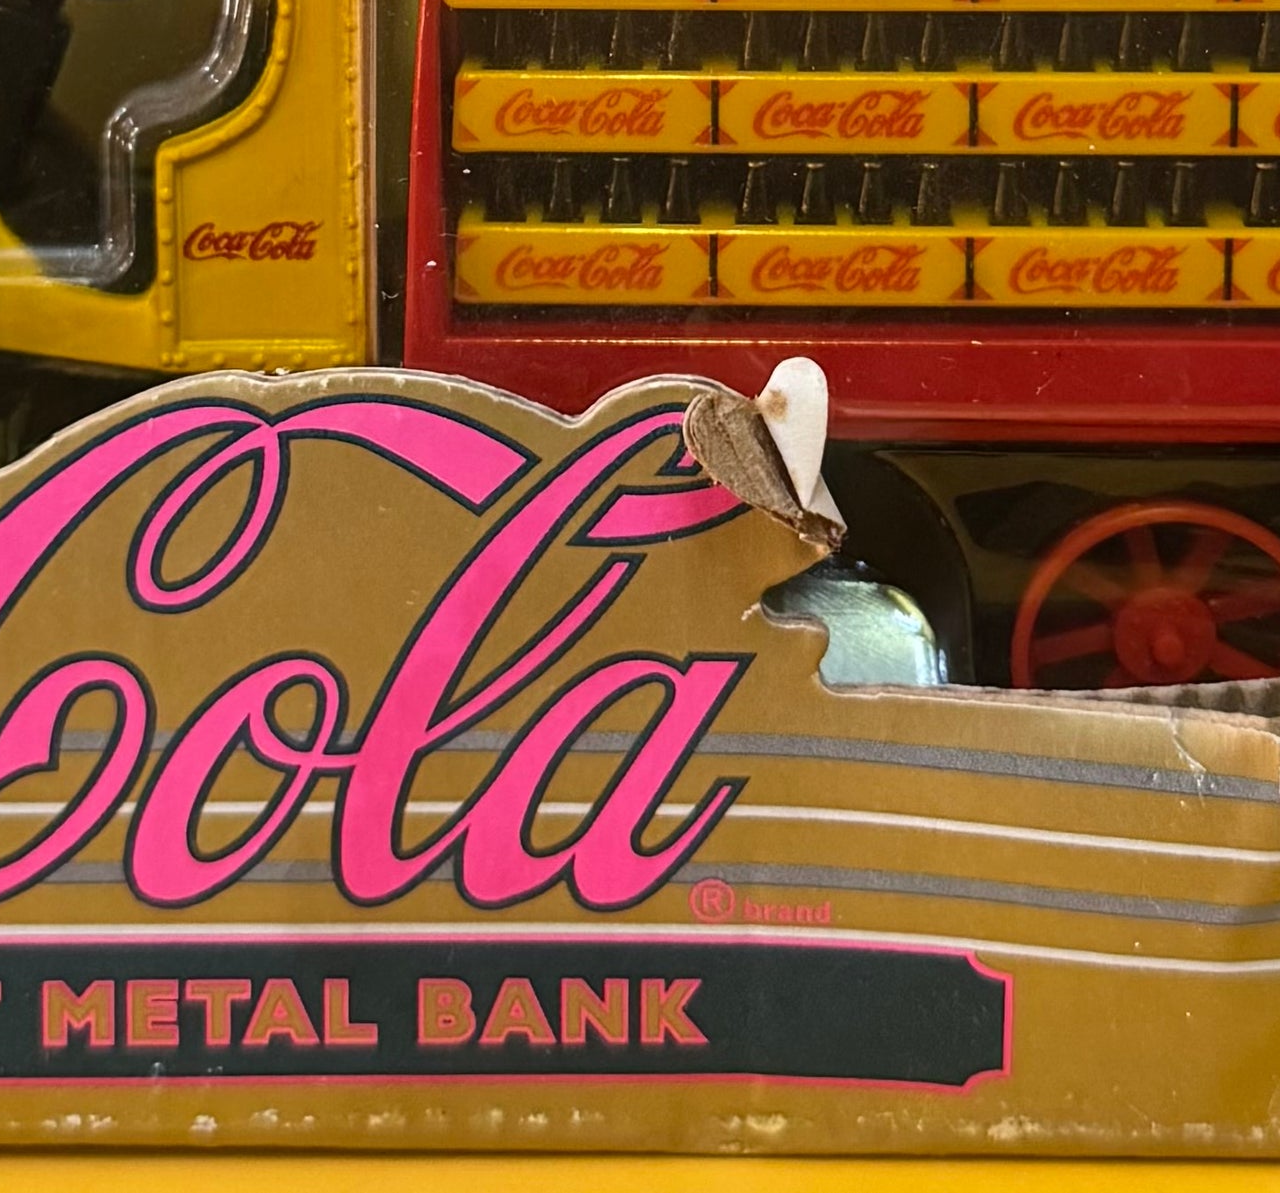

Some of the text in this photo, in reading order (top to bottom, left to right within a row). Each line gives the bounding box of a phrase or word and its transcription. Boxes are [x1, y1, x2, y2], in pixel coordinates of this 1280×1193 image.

[495, 88, 672, 137] Coca-Cola
[752, 90, 933, 140] Coca-Cola
[1013, 91, 1194, 141] Coca-Cola
[183, 221, 324, 261] Coca-Cola
[495, 242, 672, 293] Coca-Cola
[751, 244, 929, 295] Coca-Cola
[1008, 245, 1188, 294] Coca-Cola
[742, 898, 832, 925] brand
[41, 977, 380, 1048] METAL
[415, 977, 710, 1048] BANK
